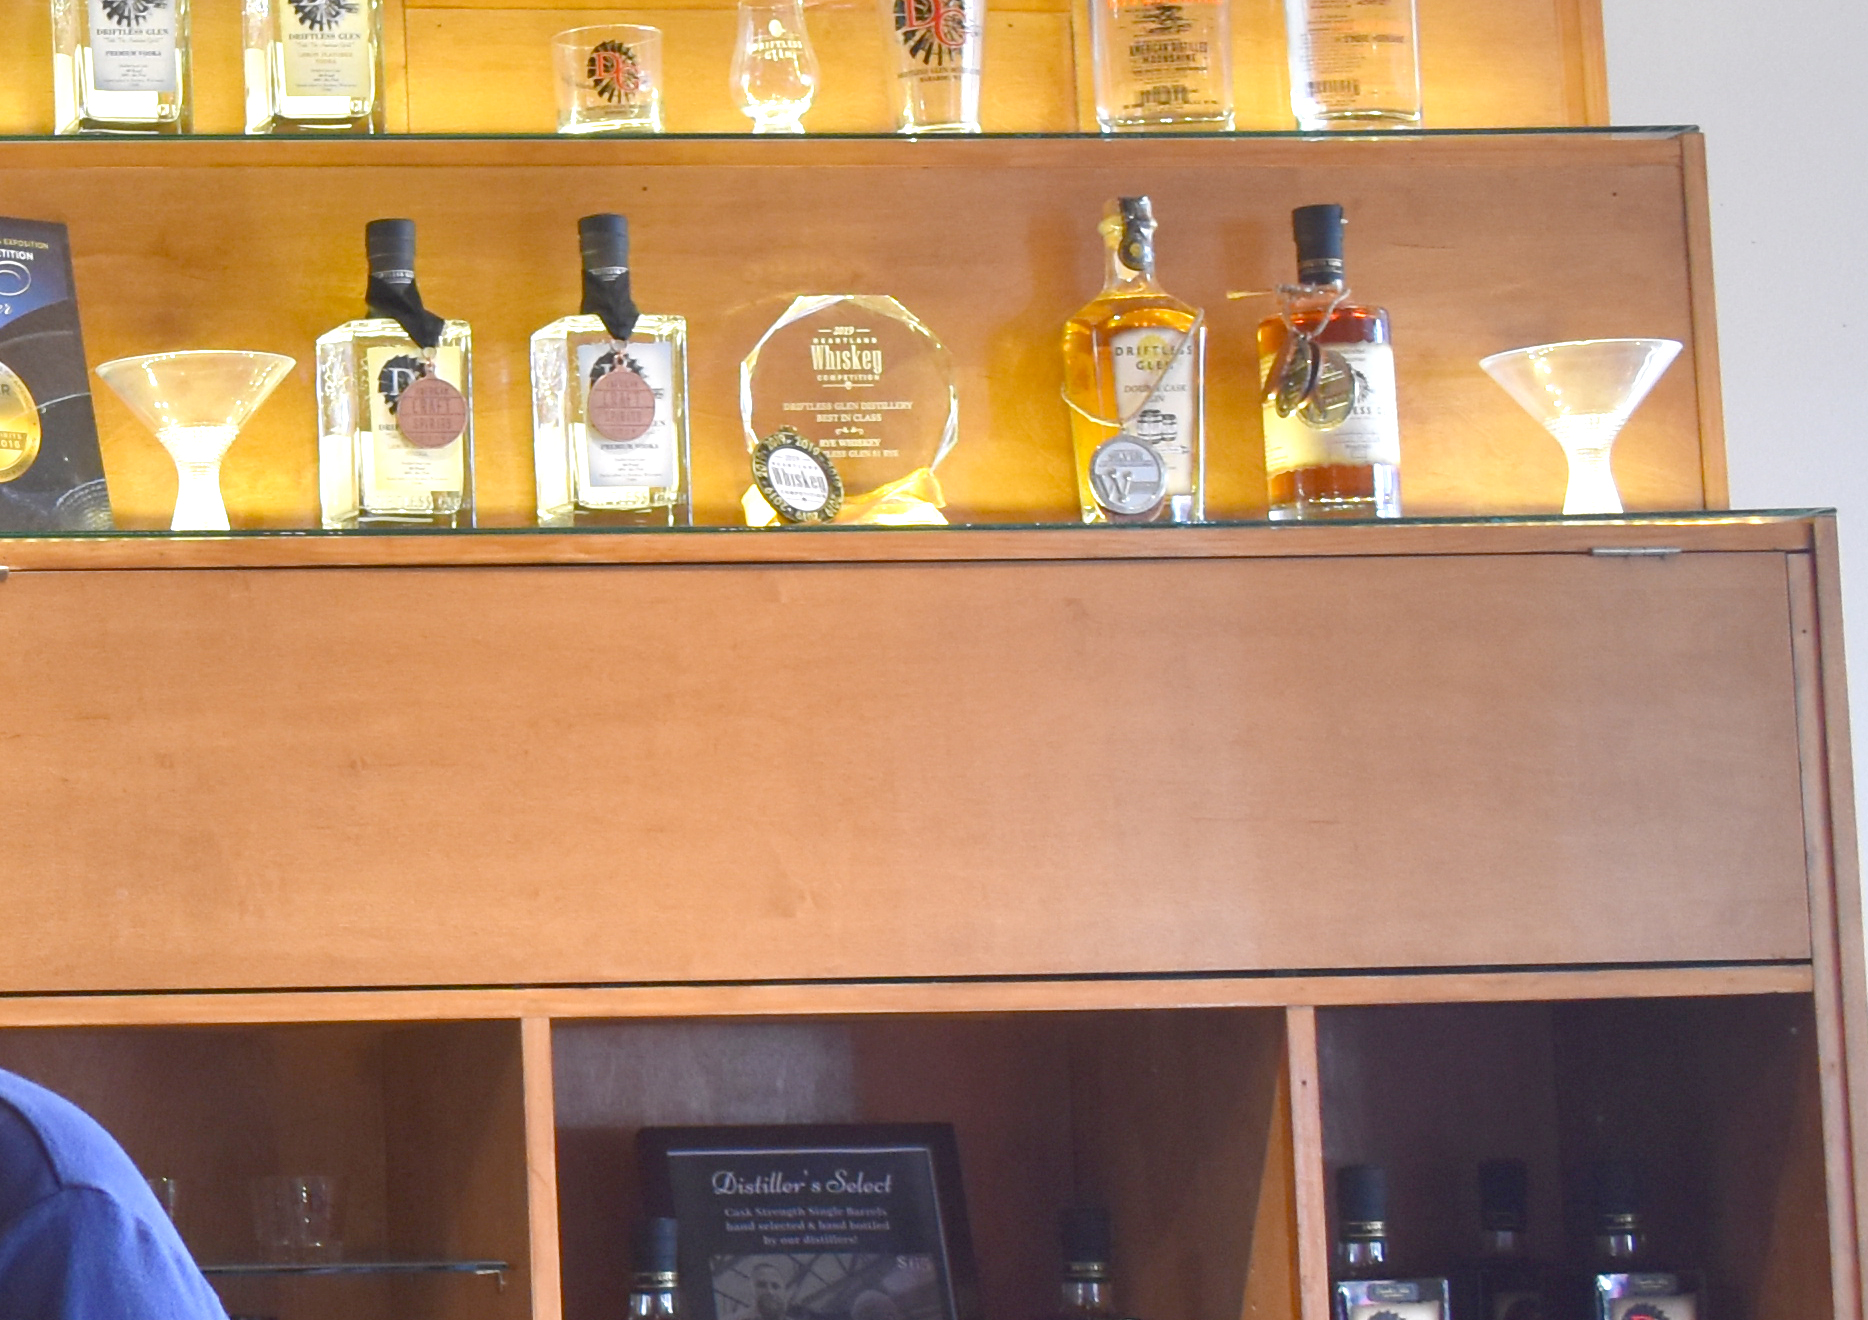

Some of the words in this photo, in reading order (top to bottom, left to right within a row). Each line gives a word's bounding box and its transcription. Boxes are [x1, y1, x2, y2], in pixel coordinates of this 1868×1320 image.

[1114, 345, 1193, 358] DRIFTLESS
[810, 344, 883, 375] Whiskey
[816, 373, 880, 381] COMPETITION
[783, 401, 832, 412] DRIFTLESS
[834, 401, 857, 411] GLEN
[858, 401, 913, 411] DISTILLERY
[816, 413, 841, 422] BEST
[852, 413, 882, 422] CLASS
[839, 438, 881, 447] WHISKEY
[773, 466, 826, 491] Whiskey
[712, 1169, 821, 1195] Distiller's
[825, 1168, 893, 1194] Select
[724, 1207, 752, 1218] Cask
[754, 1206, 805, 1219] Strength
[807, 1206, 844, 1219] Single
[845, 1206, 888, 1217] Barrels
[725, 1221, 755, 1232] hand
[758, 1221, 806, 1231] selected
[817, 1221, 847, 1231] hand
[848, 1220, 891, 1231] bottled
[802, 1234, 860, 1245] distillers!
